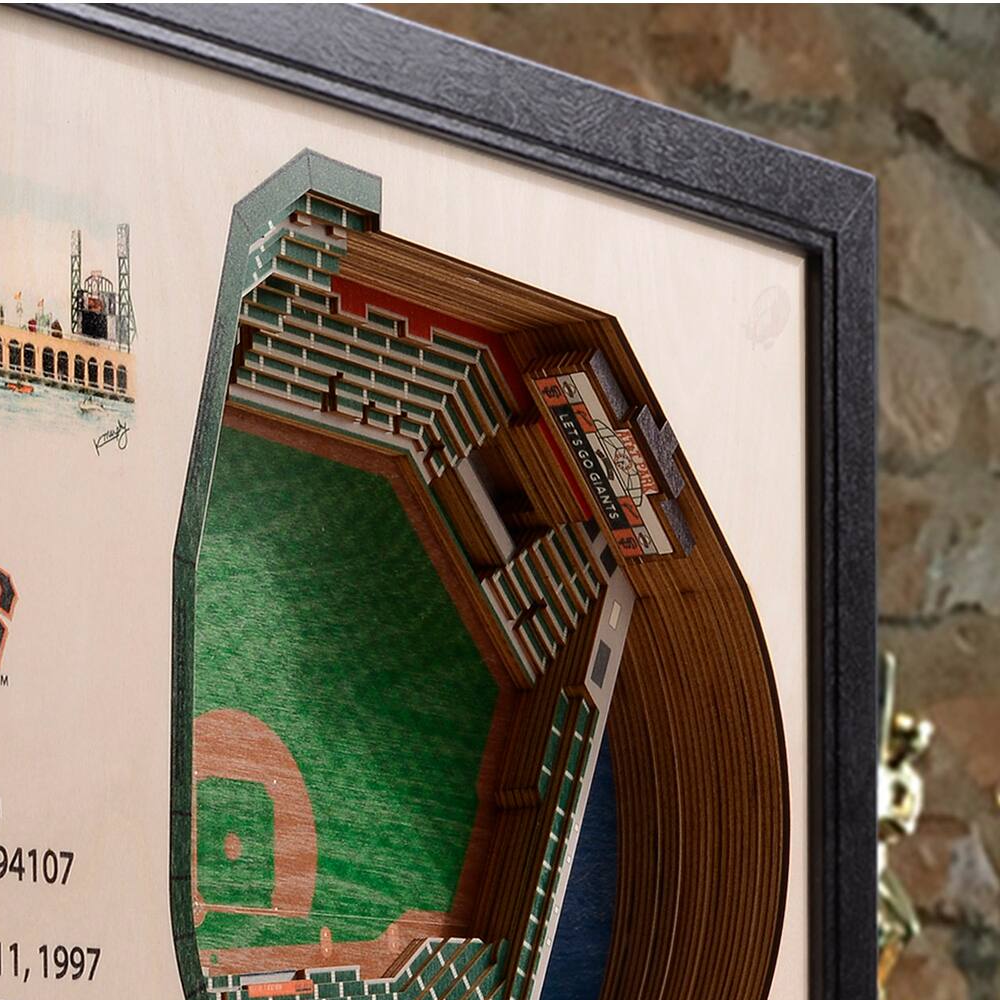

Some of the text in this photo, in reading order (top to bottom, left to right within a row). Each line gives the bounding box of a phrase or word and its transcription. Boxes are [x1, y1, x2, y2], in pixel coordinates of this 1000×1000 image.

[559, 413, 583, 447] LETS
[577, 449, 594, 470] GO
[589, 472, 620, 520] GIANTS
[636, 463, 659, 493] PARK
[38, 944, 101, 981] 1997
